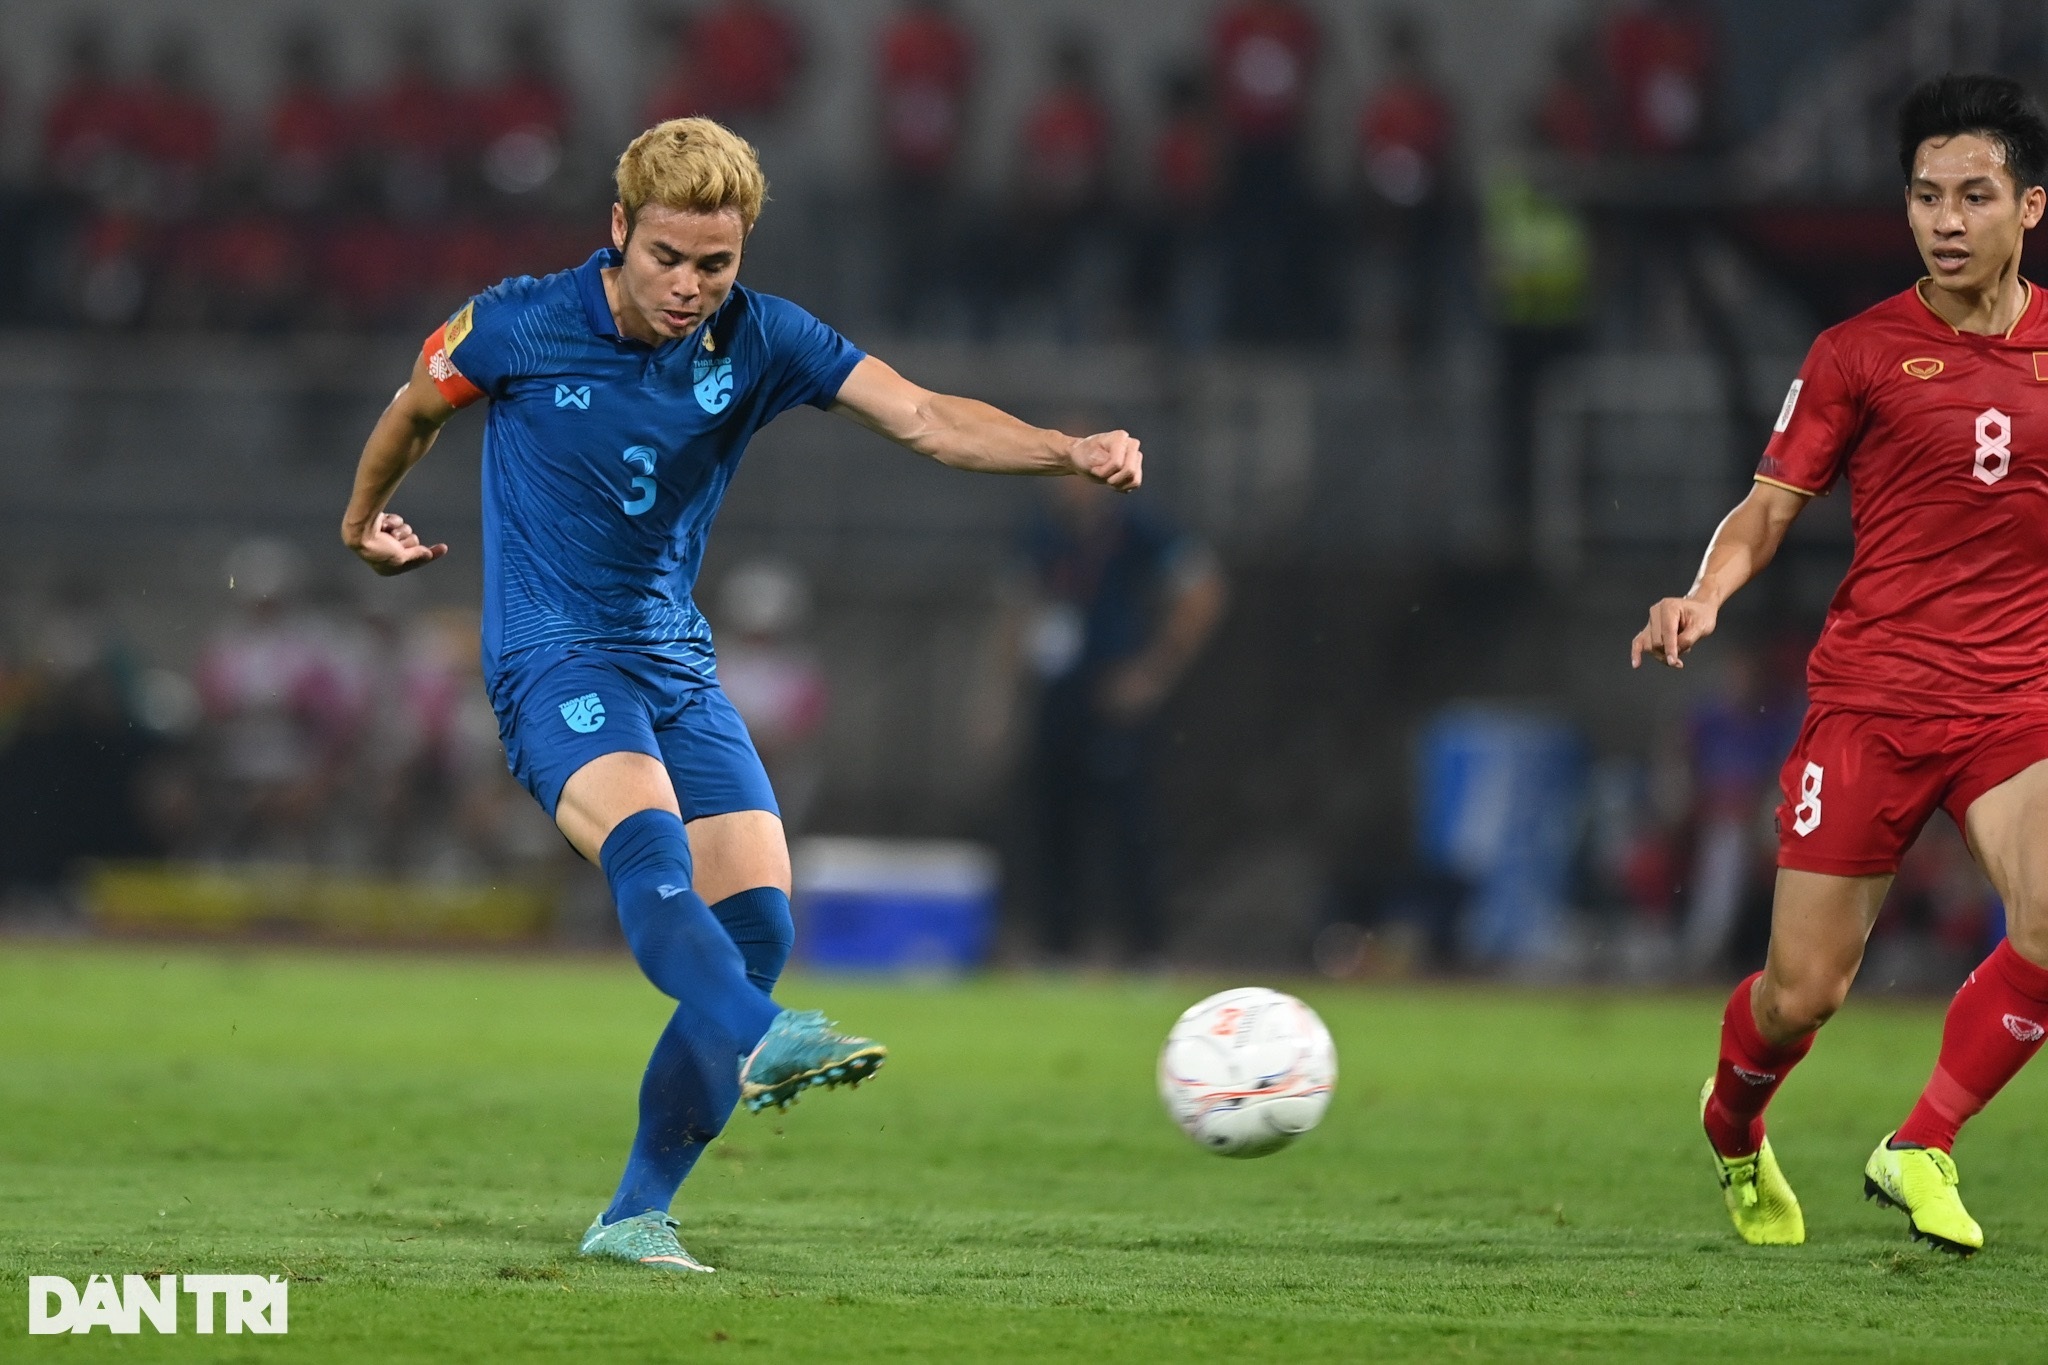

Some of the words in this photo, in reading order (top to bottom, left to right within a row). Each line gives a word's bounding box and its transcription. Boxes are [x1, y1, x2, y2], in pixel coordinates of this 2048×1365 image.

[623, 445, 657, 515] 3
[1973, 407, 2011, 486] 8
[1792, 760, 1824, 837] 8
